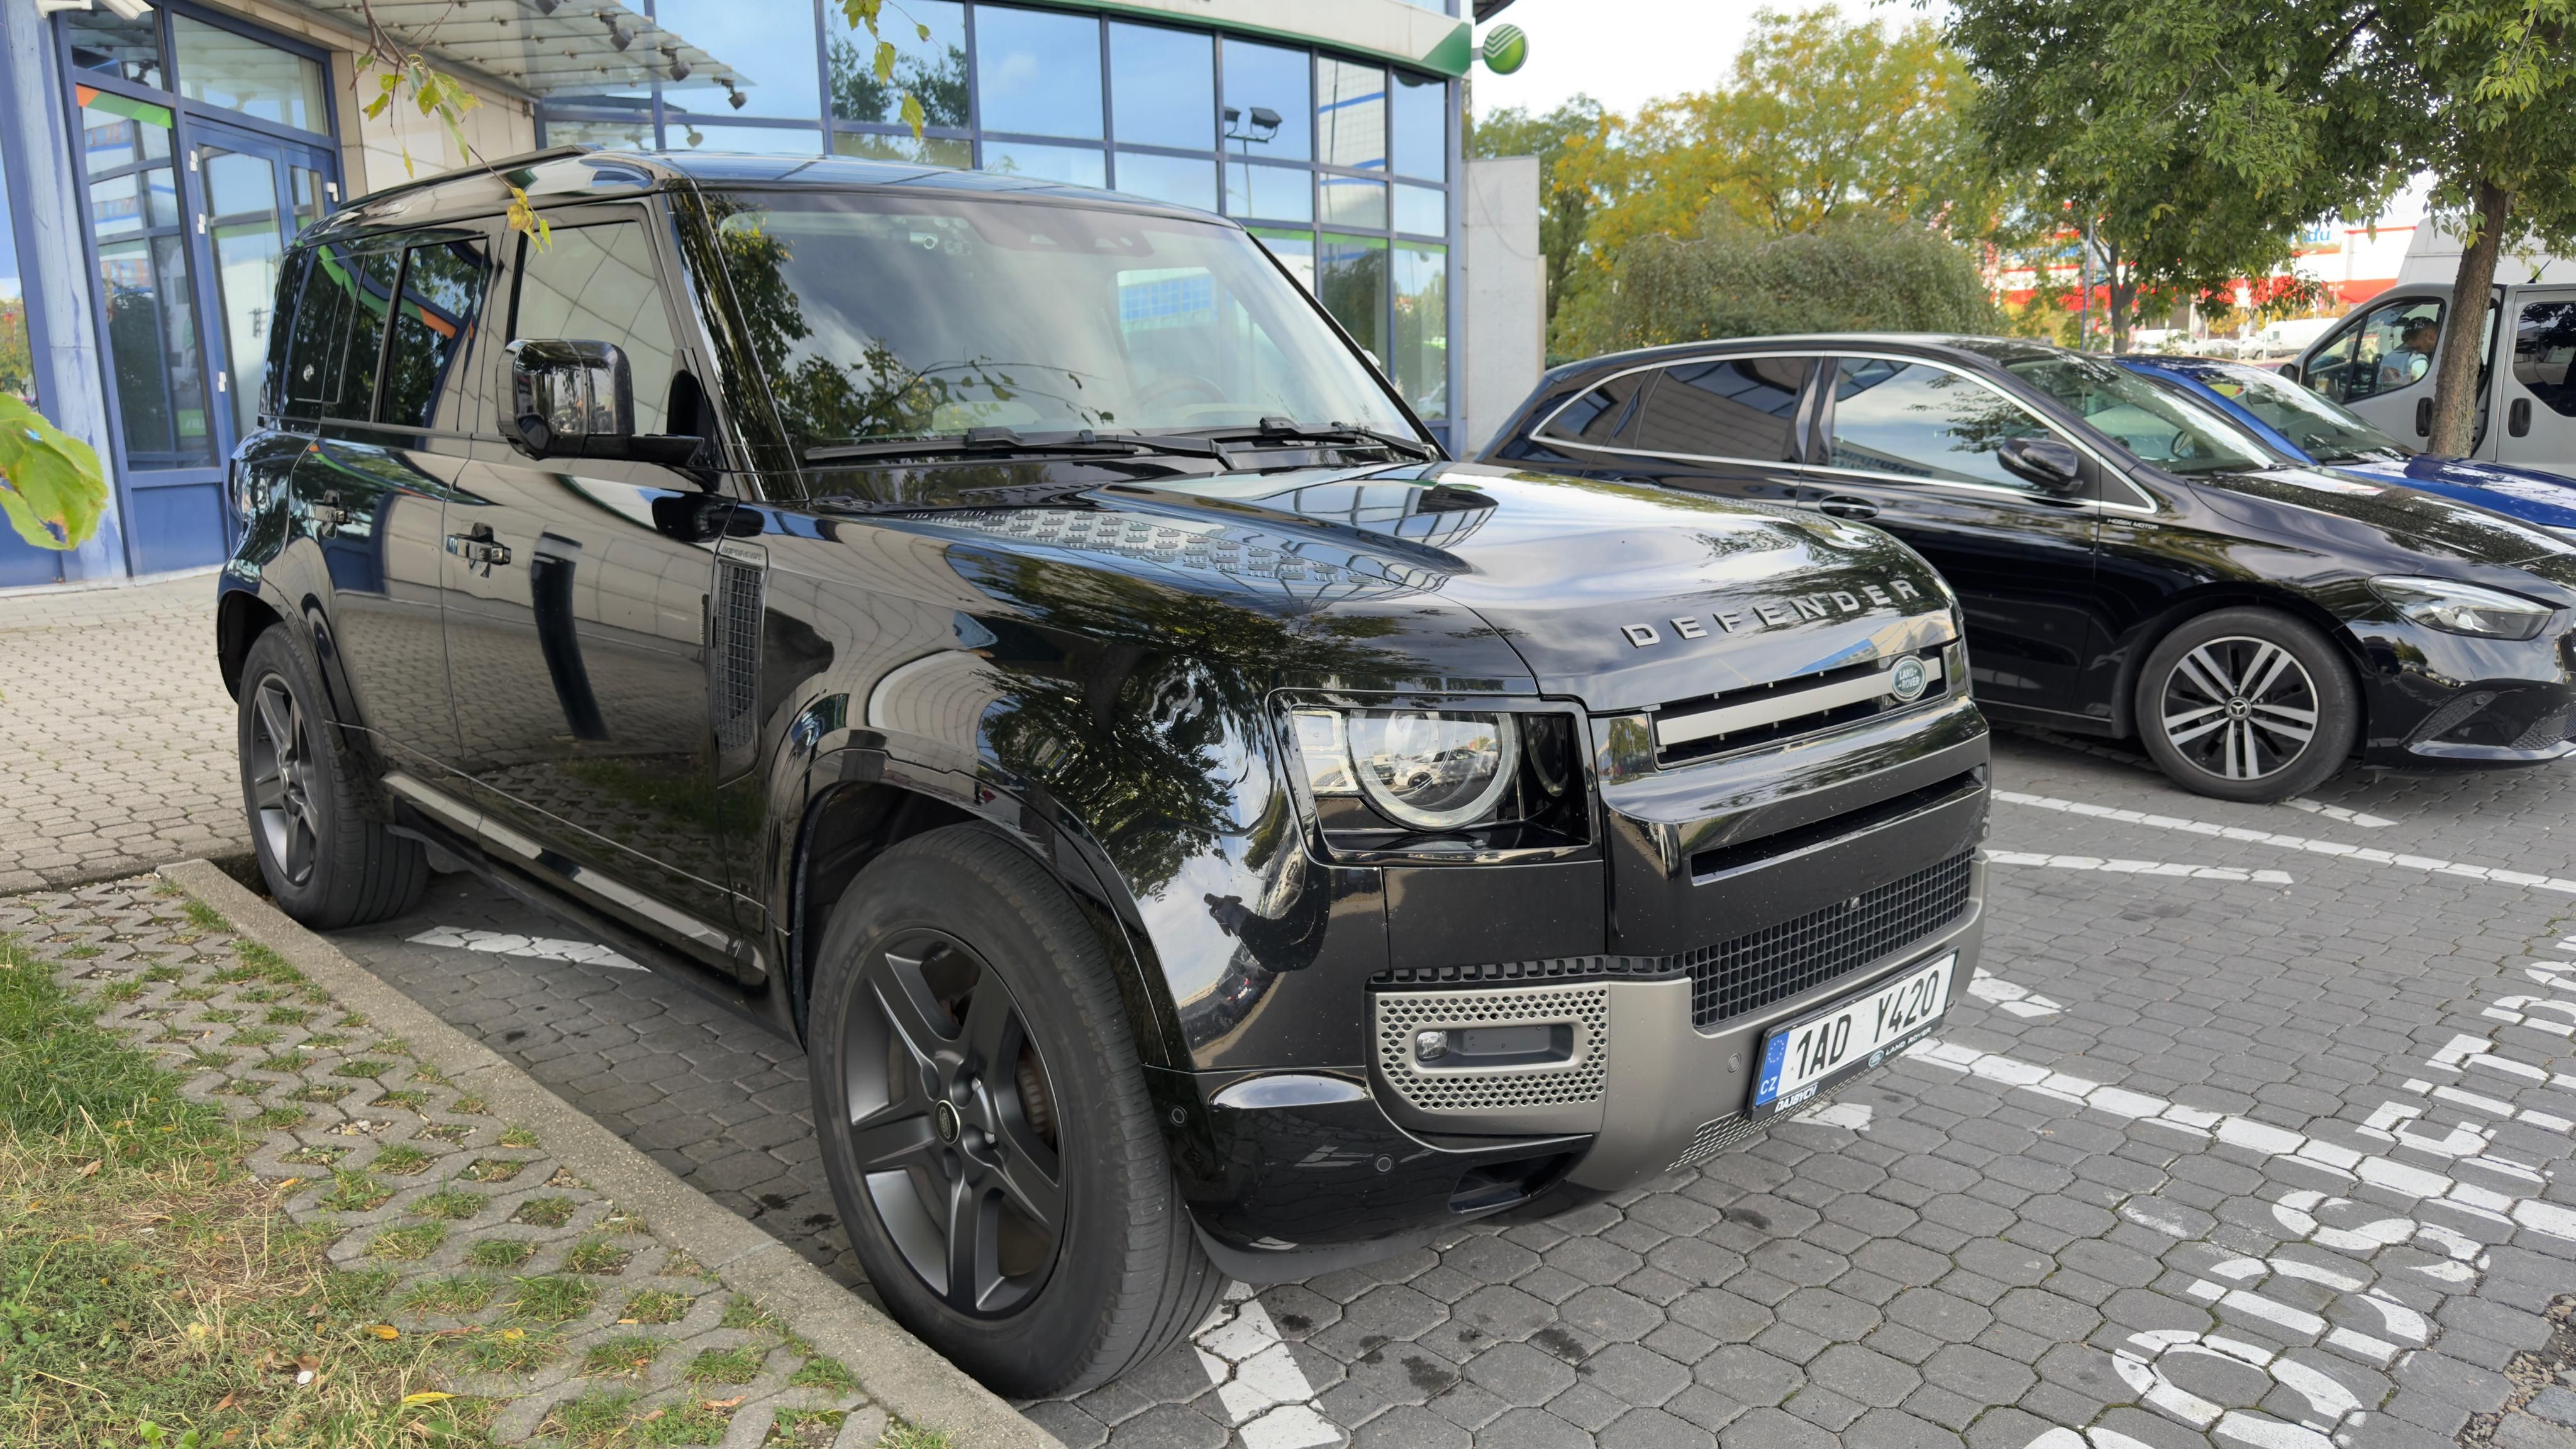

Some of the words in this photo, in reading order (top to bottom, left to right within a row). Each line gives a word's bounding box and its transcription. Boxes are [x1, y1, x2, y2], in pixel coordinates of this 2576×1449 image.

[2133, 521, 2159, 530] MOTOR
[1621, 579, 1920, 648] DEFENDER
[1899, 668, 1914, 680] LAND
[1902, 676, 1920, 689] ROVER
[1796, 1013, 1852, 1080] 1AD
[1874, 969, 1939, 1043] Y420
[1885, 1041, 1906, 1056] LAND
[1908, 1026, 1932, 1045] ROVER
[1760, 1075, 1779, 1096] CZ
[1774, 1082, 1818, 1113] DAJBYCH
